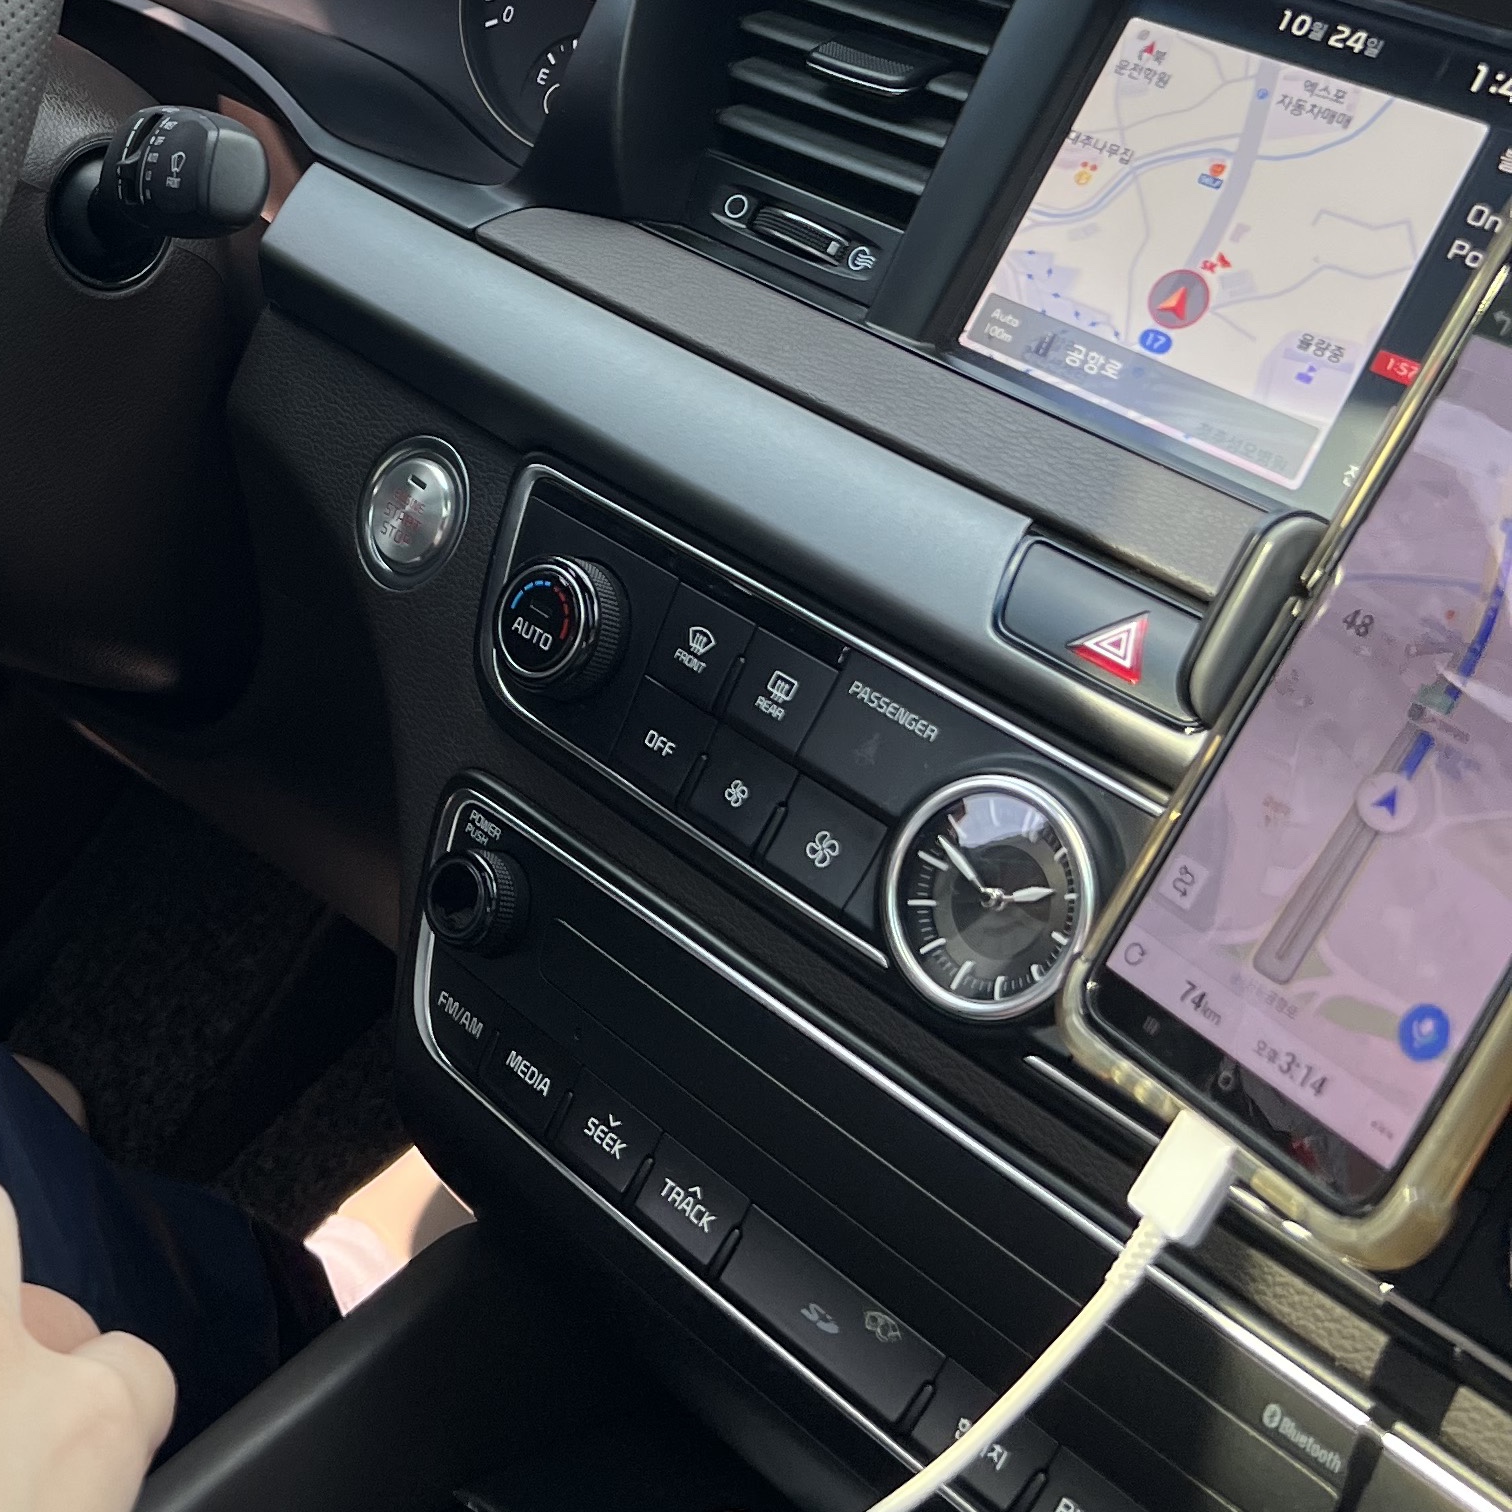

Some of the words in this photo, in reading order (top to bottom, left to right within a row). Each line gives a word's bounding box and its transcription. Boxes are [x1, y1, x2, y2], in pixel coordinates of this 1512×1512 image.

[502, 5, 515, 23] 0
[1278, 8, 1328, 42] 10월
[1327, 23, 1385, 58] 24일
[536, 67, 549, 85] E
[991, 307, 1021, 329] Auto
[1144, 331, 1167, 350] 17
[1064, 342, 1124, 381] 공항로
[380, 520, 410, 545] STOP
[510, 615, 554, 653] AUTO
[673, 646, 708, 675] FRONT
[753, 693, 786, 722] REAR
[847, 680, 940, 744] PASSENGER
[644, 728, 677, 758] OFF
[465, 822, 489, 846] PUSH
[469, 809, 502, 841] POWER
[437, 990, 485, 1039] FM/AM
[505, 1049, 552, 1098] MEDIA
[583, 1116, 628, 1161] SEEK
[660, 1176, 717, 1235] TRACK
[1278, 1414, 1344, 1475] Bluetooth
